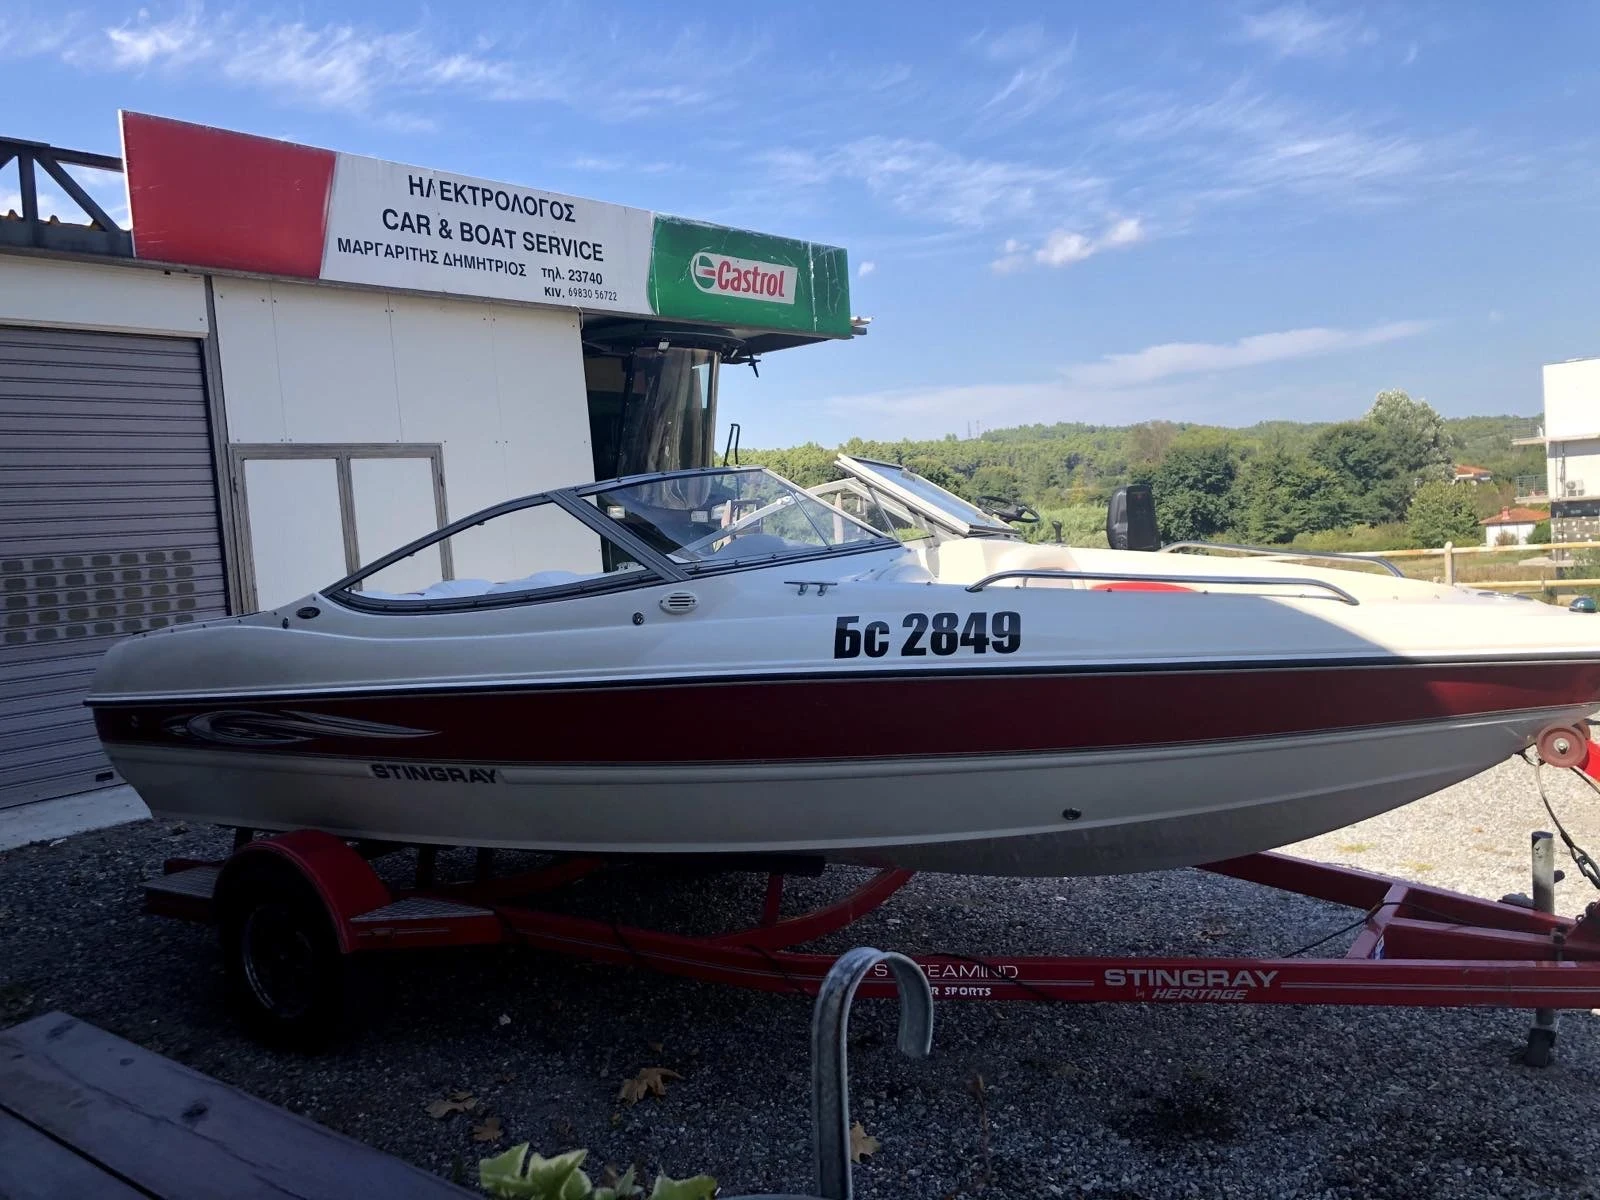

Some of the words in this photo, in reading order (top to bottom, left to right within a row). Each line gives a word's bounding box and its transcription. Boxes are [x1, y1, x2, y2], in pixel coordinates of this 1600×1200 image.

[408, 174, 576, 223] ΗΛΕΚΤΡΟΛΟΓΟΣ
[382, 208, 431, 236] CAR
[438, 218, 453, 240] &
[460, 221, 517, 250] BOAT
[522, 231, 605, 262] SERVICE
[337, 237, 440, 265] ΜΑΡΓΑΡΙΤΗΣ
[443, 252, 527, 277] ΔΗΜΗΤΡΙΟΣ
[568, 269, 603, 285] 23740
[717, 260, 785, 298] Castrol
[568, 287, 592, 299] 69830
[594, 289, 618, 301] 56722
[901, 611, 1022, 656] 2849
[370, 764, 497, 784] STINGRAY
[944, 986, 992, 997] SPORTS
[1104, 968, 1279, 988] STINGRAY
[1152, 988, 1249, 1000] HERITAGE
